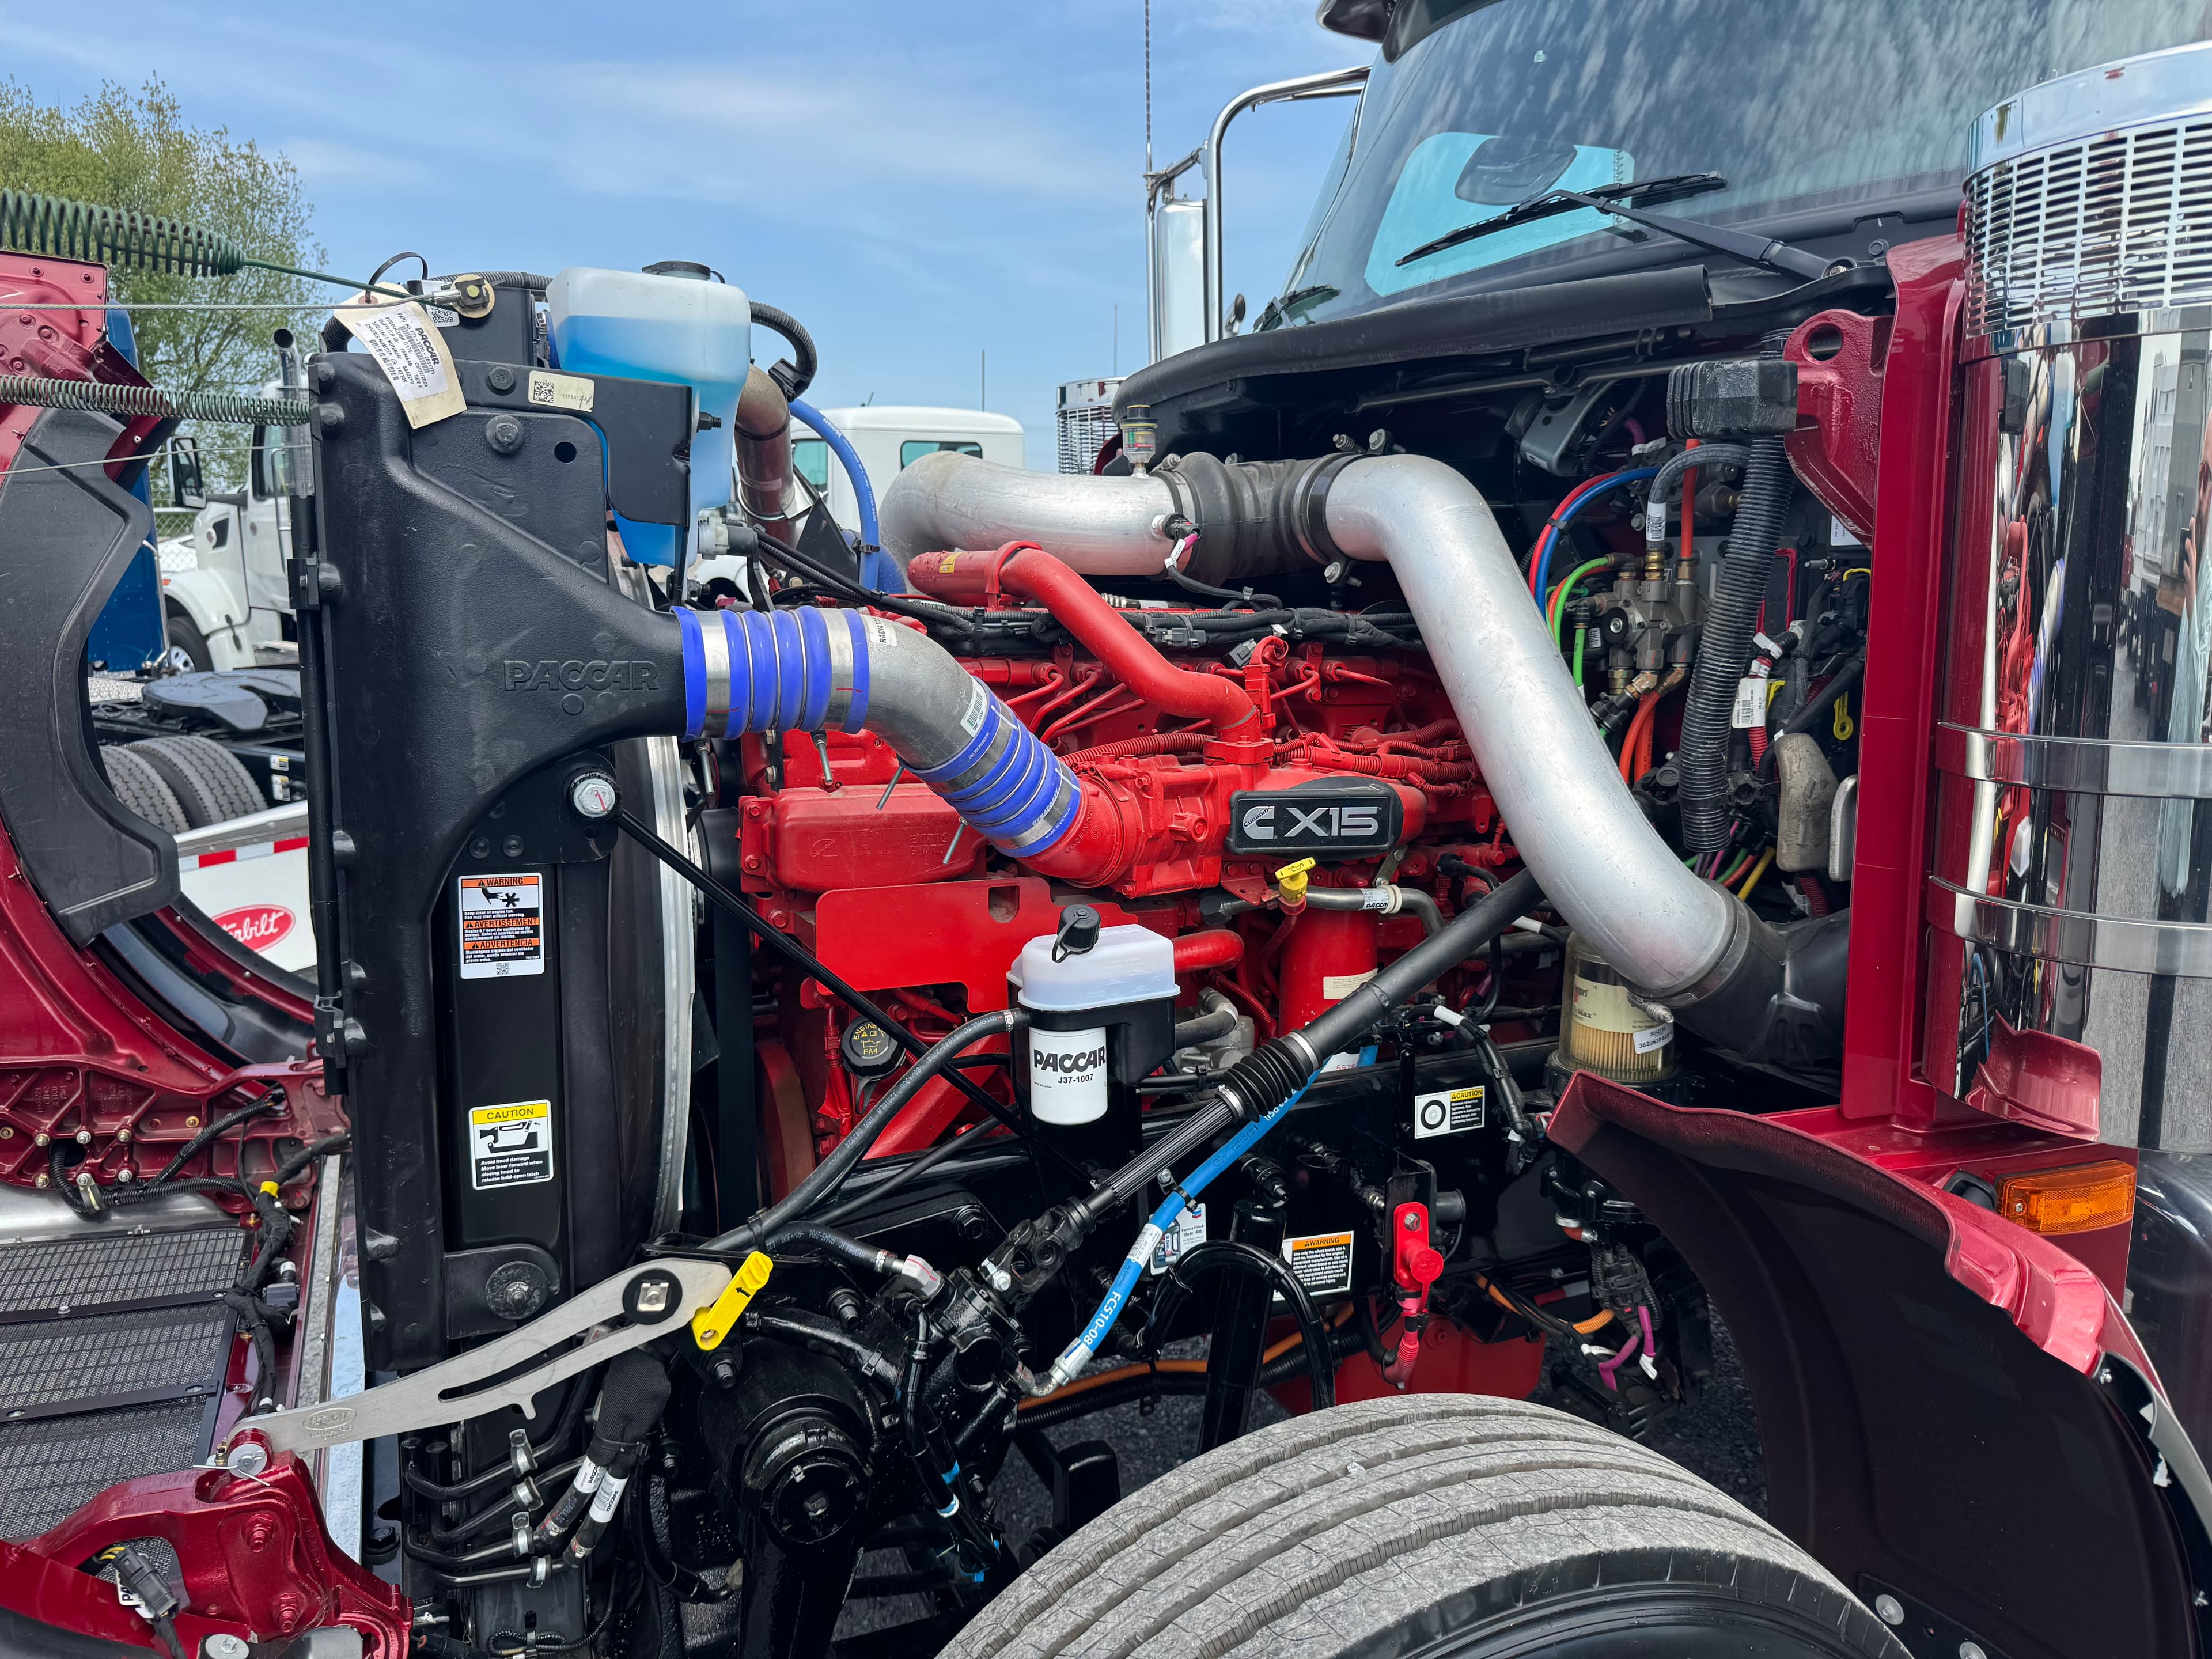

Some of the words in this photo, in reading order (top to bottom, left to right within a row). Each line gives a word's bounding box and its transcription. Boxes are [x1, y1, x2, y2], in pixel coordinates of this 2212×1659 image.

[397, 312, 407, 323] PART
[365, 323, 380, 339] CHASSIS
[372, 321, 389, 340] SEQUENCE
[385, 316, 405, 341] PRODUCTION
[415, 327, 440, 366] PACCAR
[503, 660, 659, 691] PACCAR
[1243, 806, 1274, 828] Cummins
[1283, 806, 1378, 838] X15
[487, 878, 523, 886] WARNING
[475, 918, 537, 928] AVERTISSEMENT
[480, 939, 533, 948] ADVERTENCIA
[853, 1022, 877, 1040] ENGINE
[1033, 1046, 1105, 1073] PACCAR
[1058, 1073, 1094, 1084] J37-1007
[1456, 1090, 1482, 1098] CAUTION
[487, 1108, 533, 1120] CAUTION
[862, 1116, 874, 1128] USA
[1309, 1237, 1339, 1246] WARNING
[1083, 1291, 1122, 1346] FC510-08
[588, 1465, 600, 1484] PACCA
